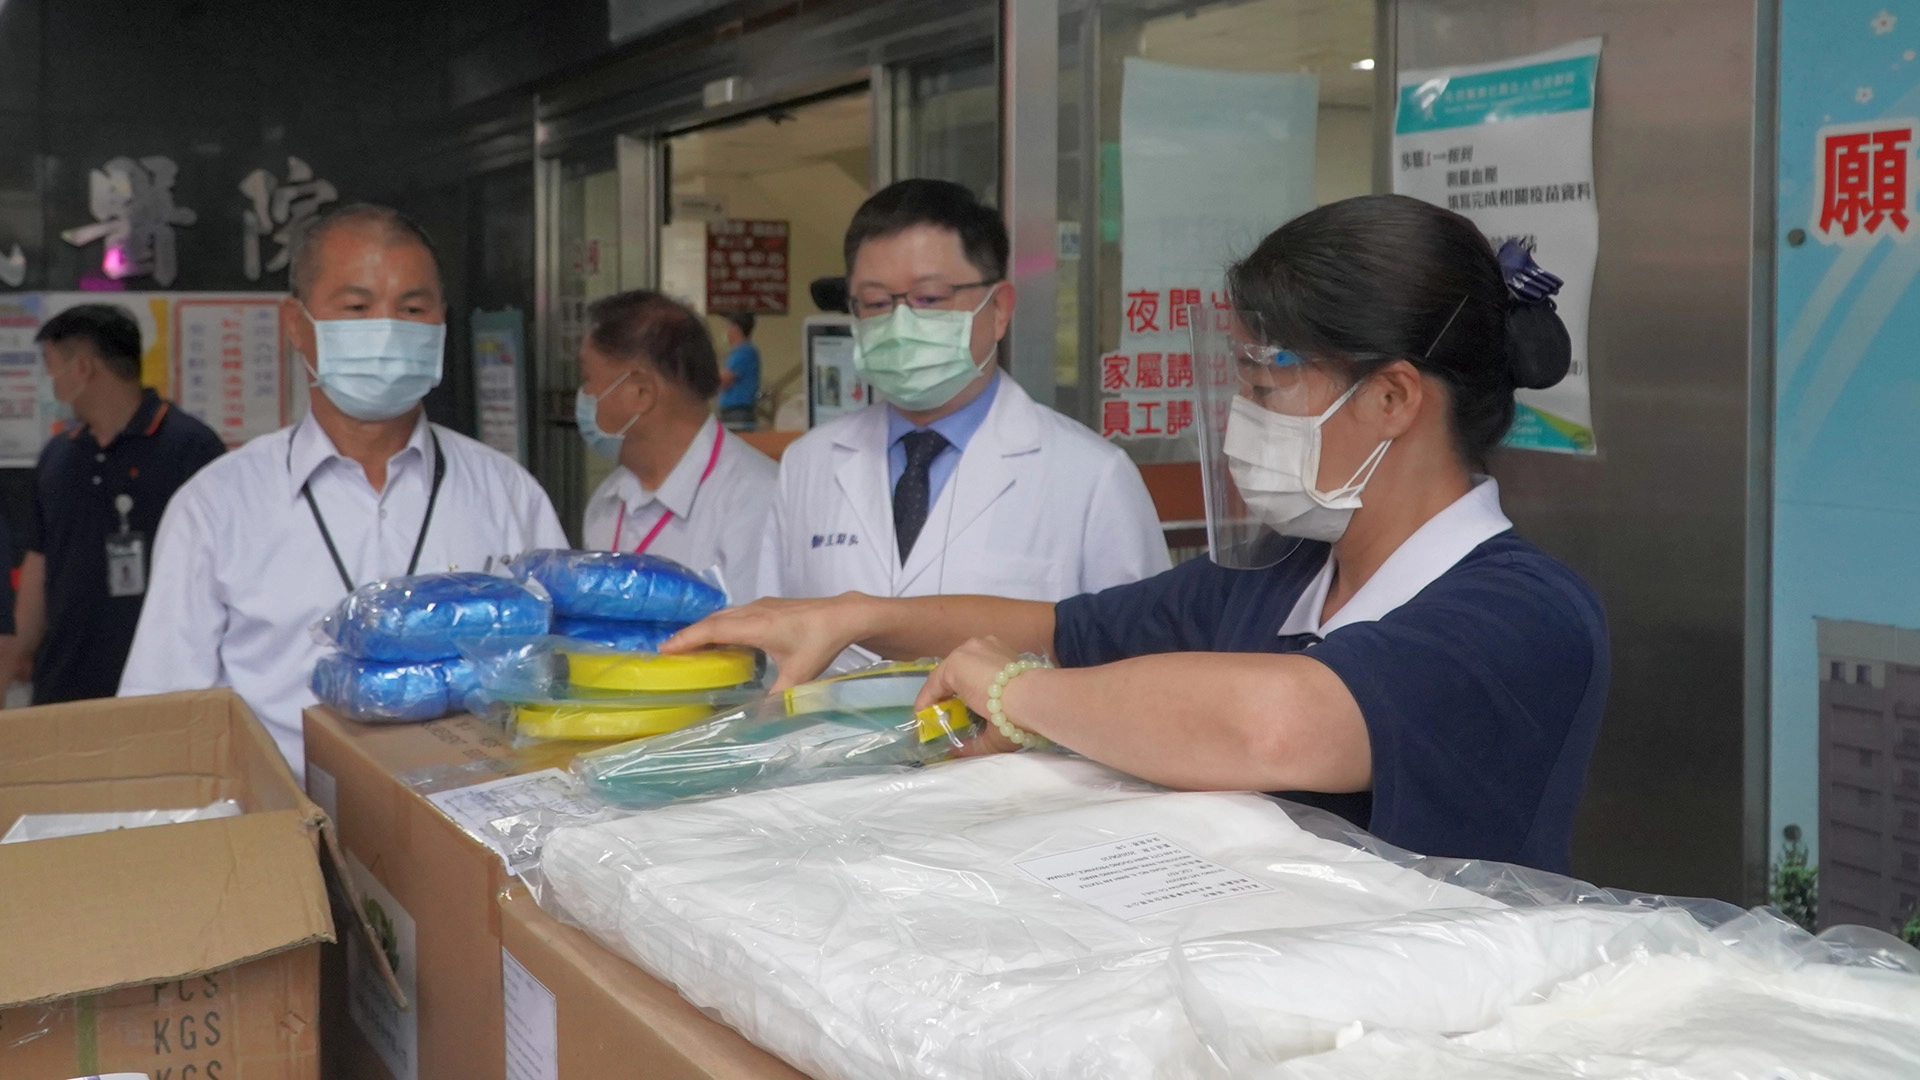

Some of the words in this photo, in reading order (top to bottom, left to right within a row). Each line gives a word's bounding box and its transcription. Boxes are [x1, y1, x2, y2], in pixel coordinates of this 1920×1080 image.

[0, 156, 338, 287] 醫院
[1820, 128, 1912, 236] 願
[153, 1011, 221, 1055] KGS
